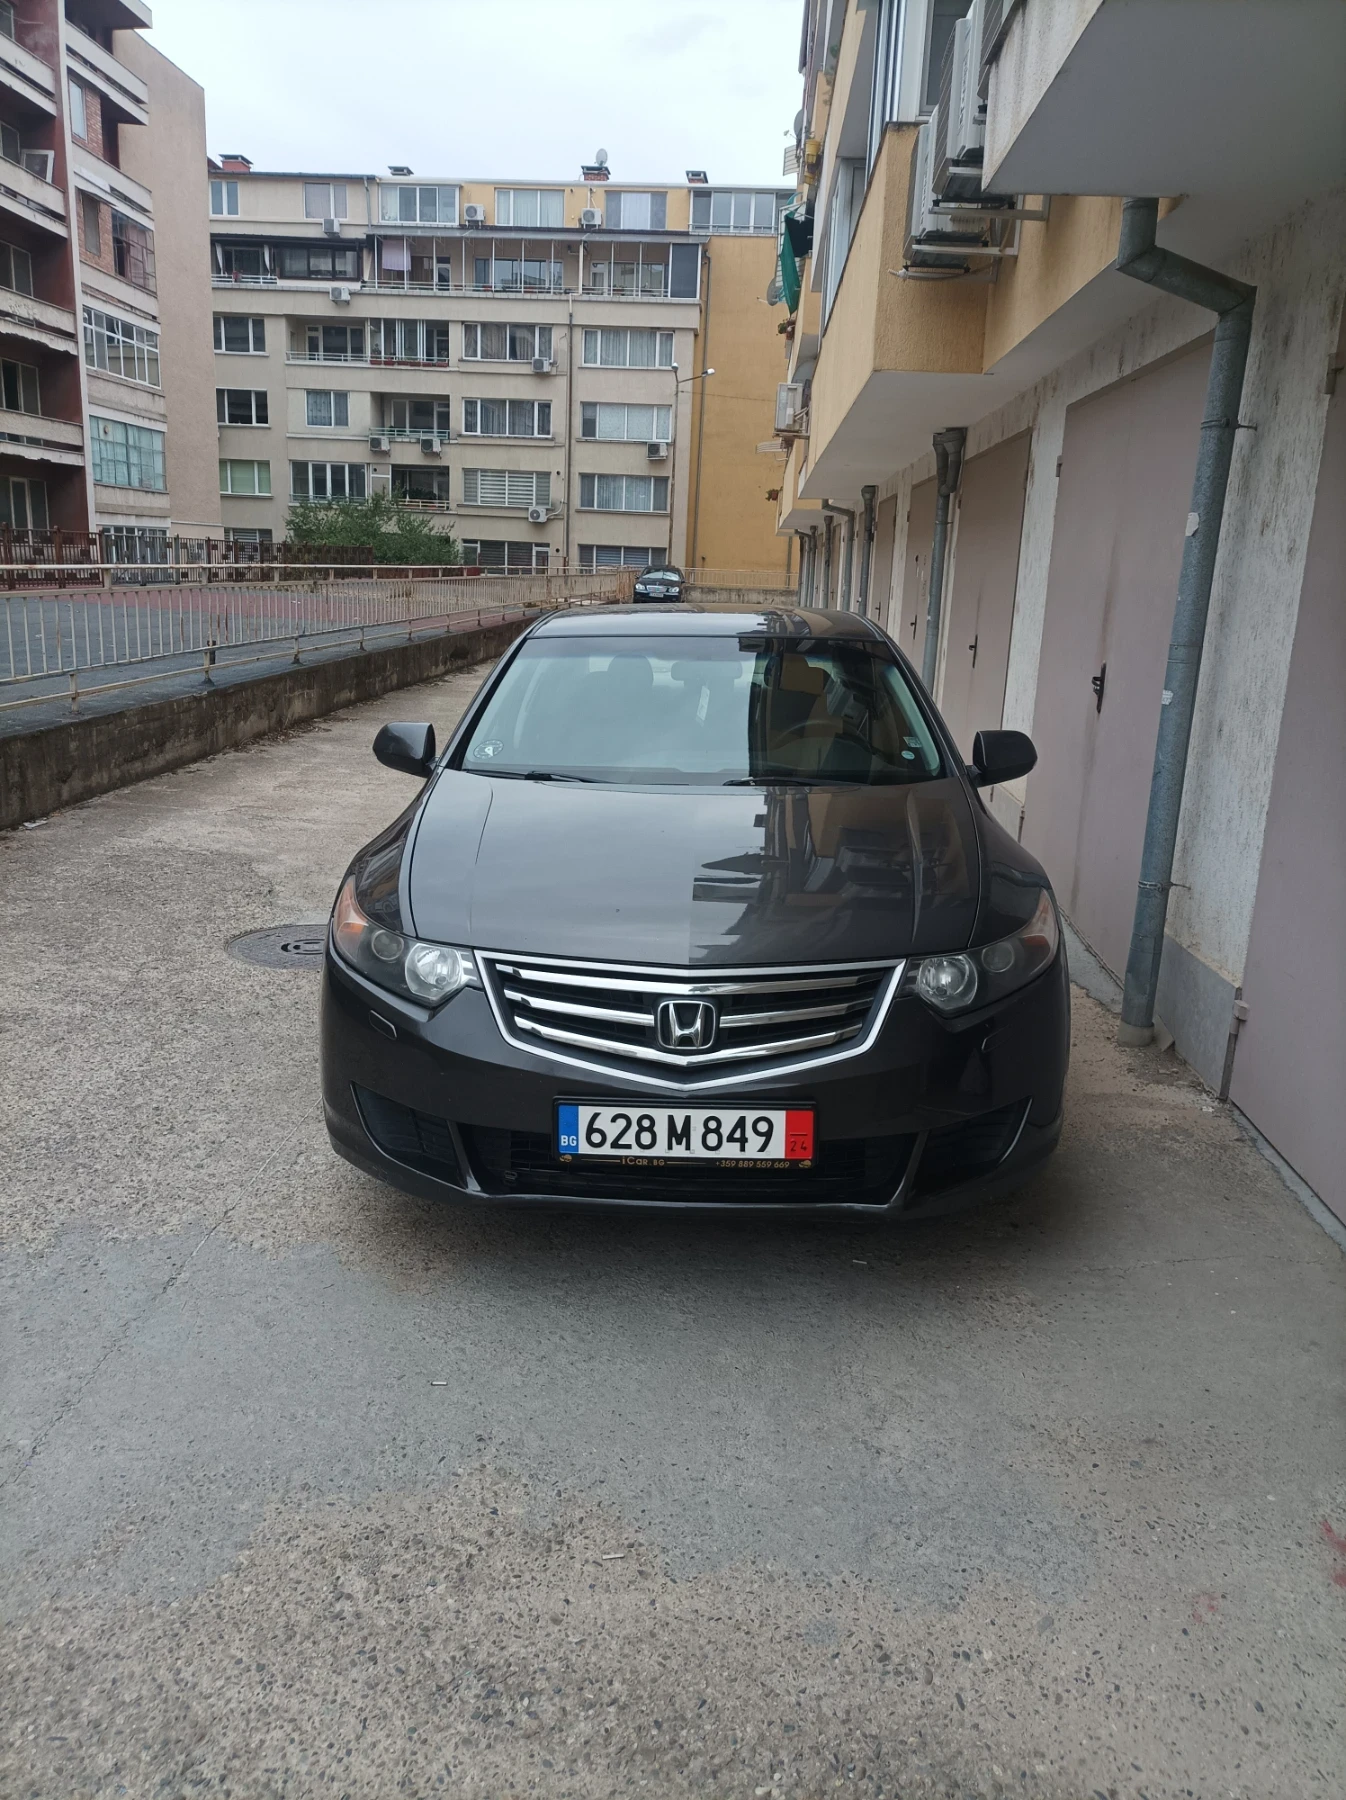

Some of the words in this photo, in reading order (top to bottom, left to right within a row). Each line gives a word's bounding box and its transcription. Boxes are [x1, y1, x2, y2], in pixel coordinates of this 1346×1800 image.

[585, 1111, 658, 1150] 628
[667, 1114, 692, 1151] M
[701, 1115, 774, 1153] 849
[560, 1134, 577, 1146] BG
[789, 1139, 808, 1152] 24
[715, 1160, 736, 1168] +359
[738, 1160, 754, 1168] 889
[773, 1161, 790, 1169] 669
